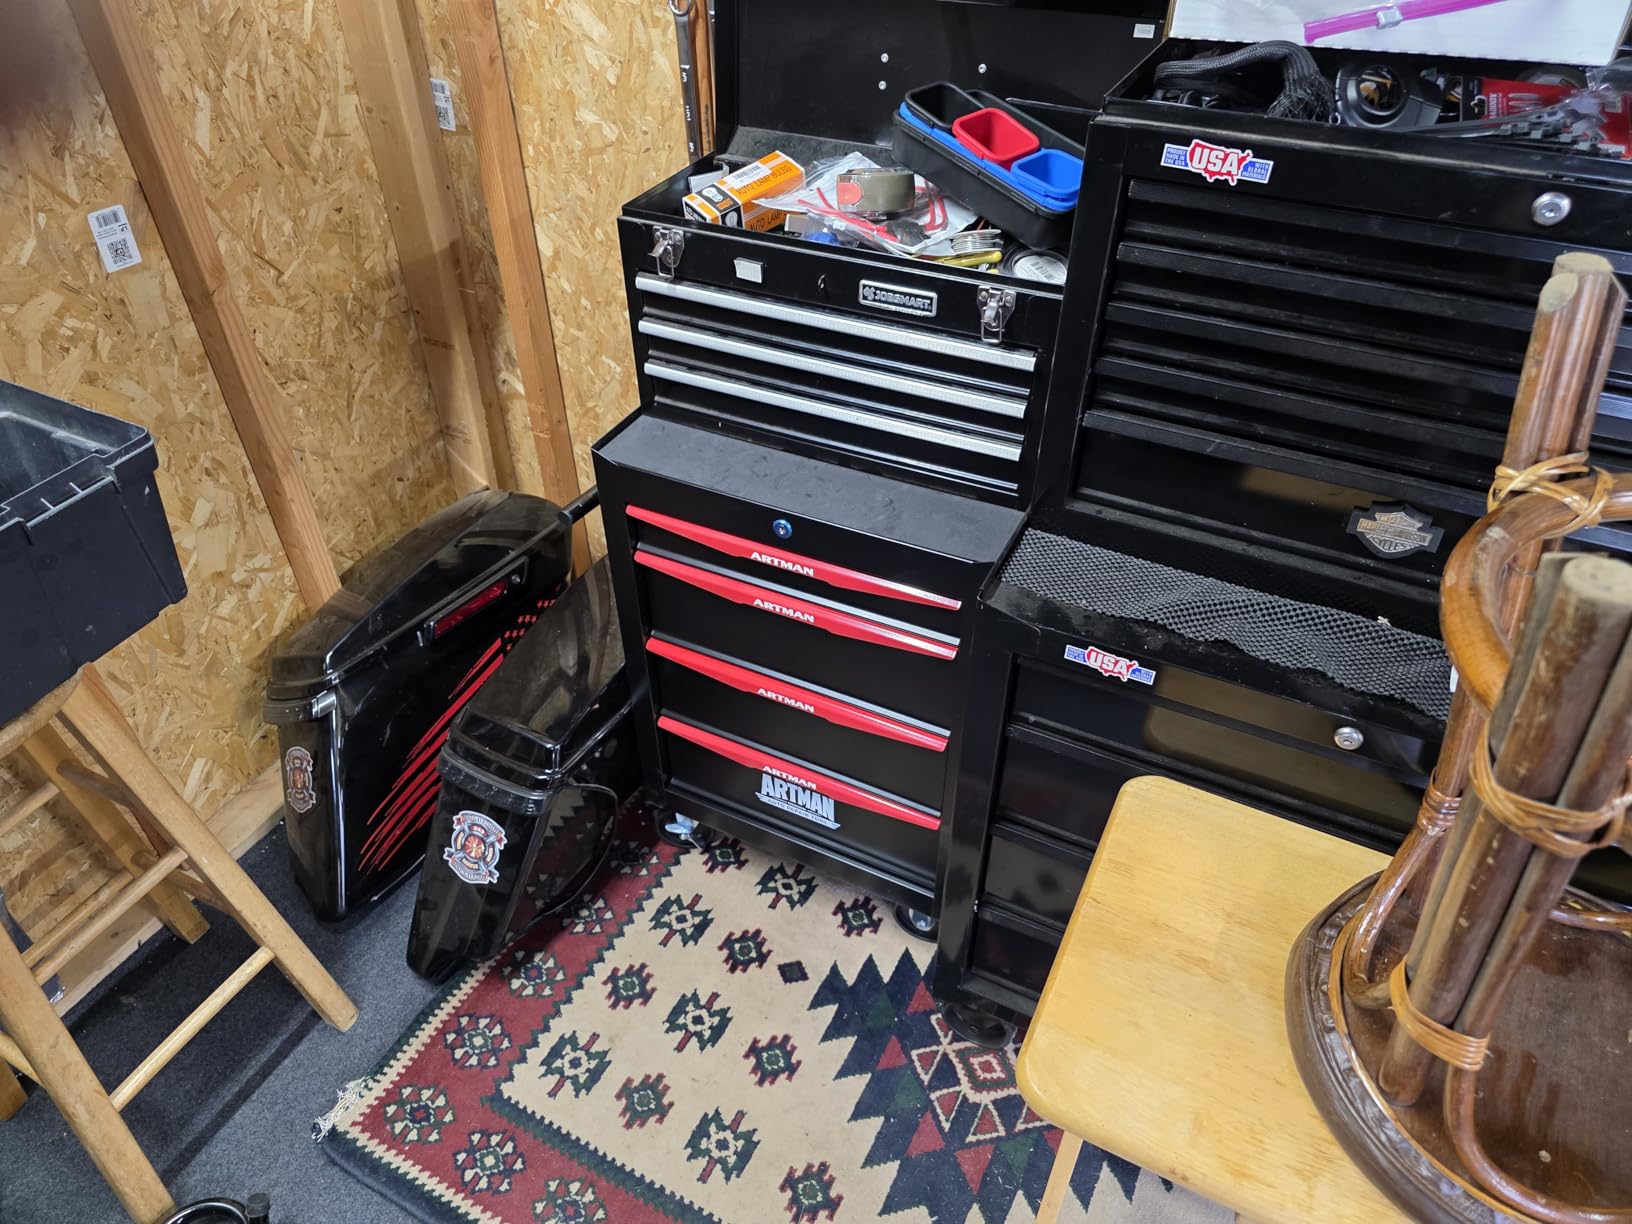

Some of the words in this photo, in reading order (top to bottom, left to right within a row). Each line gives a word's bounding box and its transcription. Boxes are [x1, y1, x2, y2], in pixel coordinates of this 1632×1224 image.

[1191, 147, 1239, 176] USA
[736, 184, 754, 197] AUTO
[756, 174, 771, 188] LAMP
[772, 165, 793, 179] BULBS
[875, 290, 931, 309] JOBSMART
[751, 552, 814, 576] ARTMAN
[753, 599, 815, 623] ARTMAN
[1089, 651, 1128, 675] USA
[757, 688, 815, 713] ARTMAN
[762, 765, 817, 790] ARTMAN
[761, 772, 835, 822] ARTMAN
